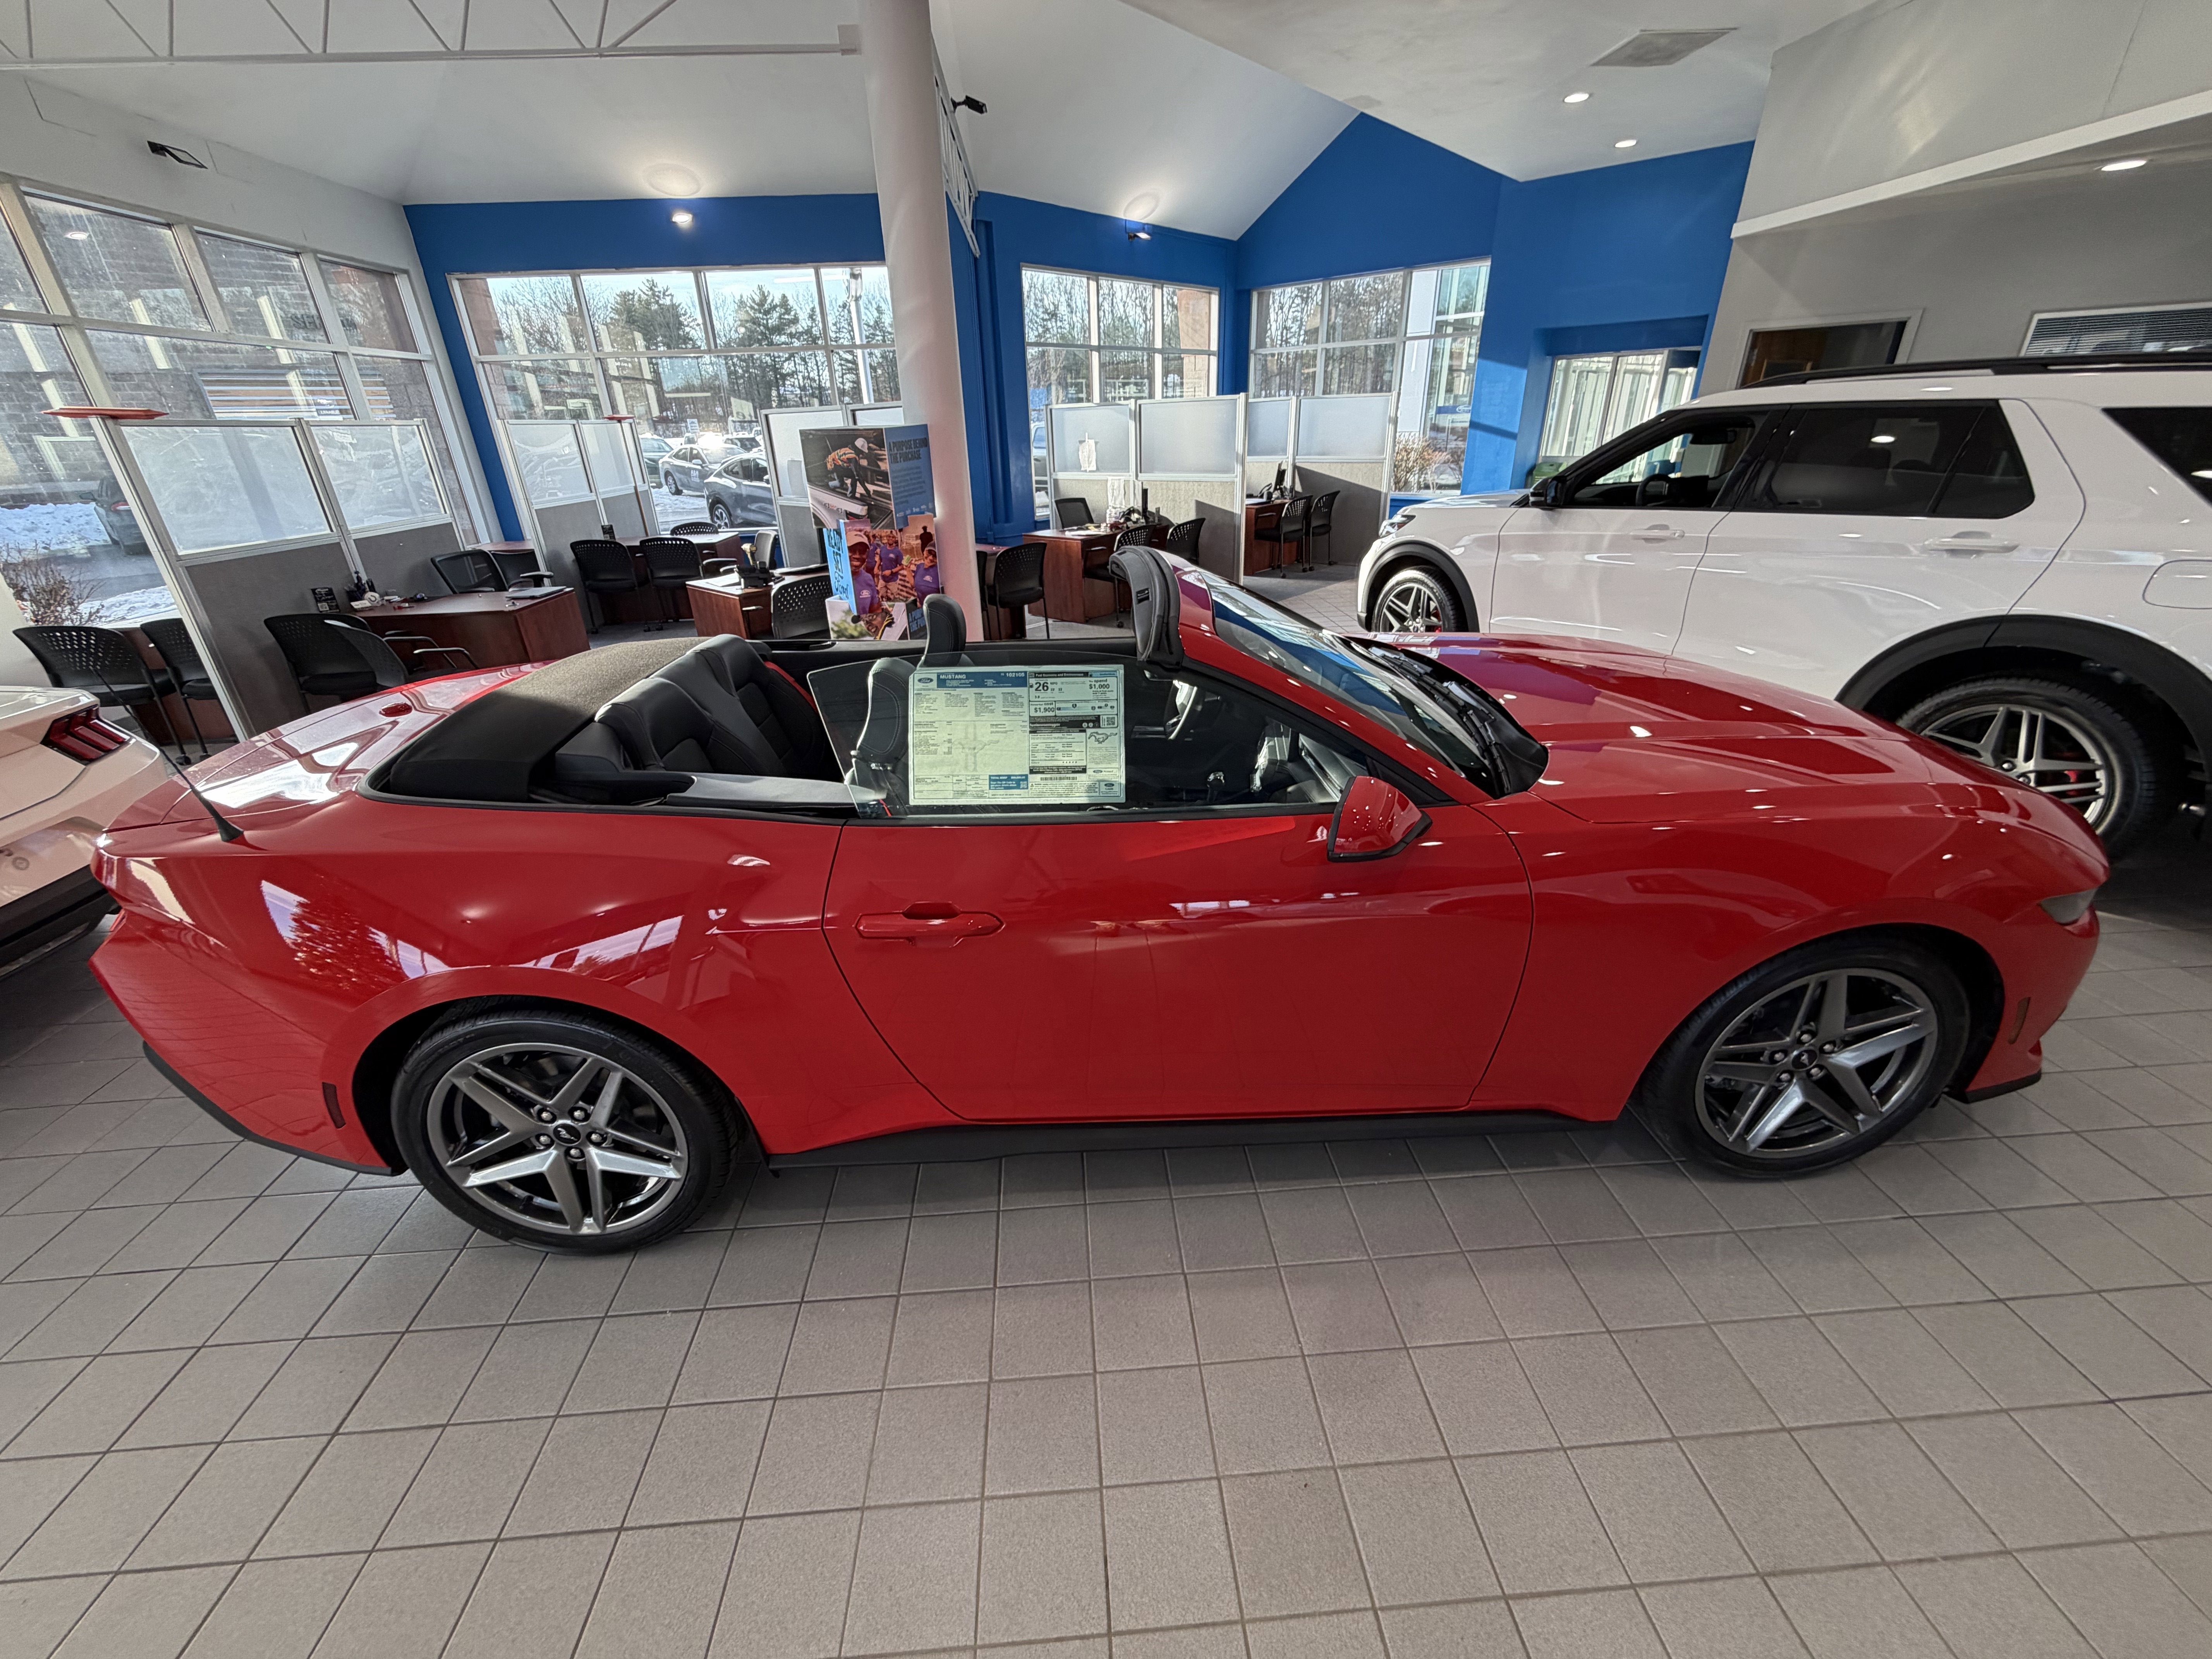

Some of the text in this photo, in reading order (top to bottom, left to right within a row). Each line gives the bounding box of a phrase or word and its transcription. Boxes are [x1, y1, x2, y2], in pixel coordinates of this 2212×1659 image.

[892, 439, 913, 452] PURPOSE
[899, 449, 922, 463] PURCHASE
[835, 571, 849, 599] Ford
[1035, 682, 1049, 692] 26
